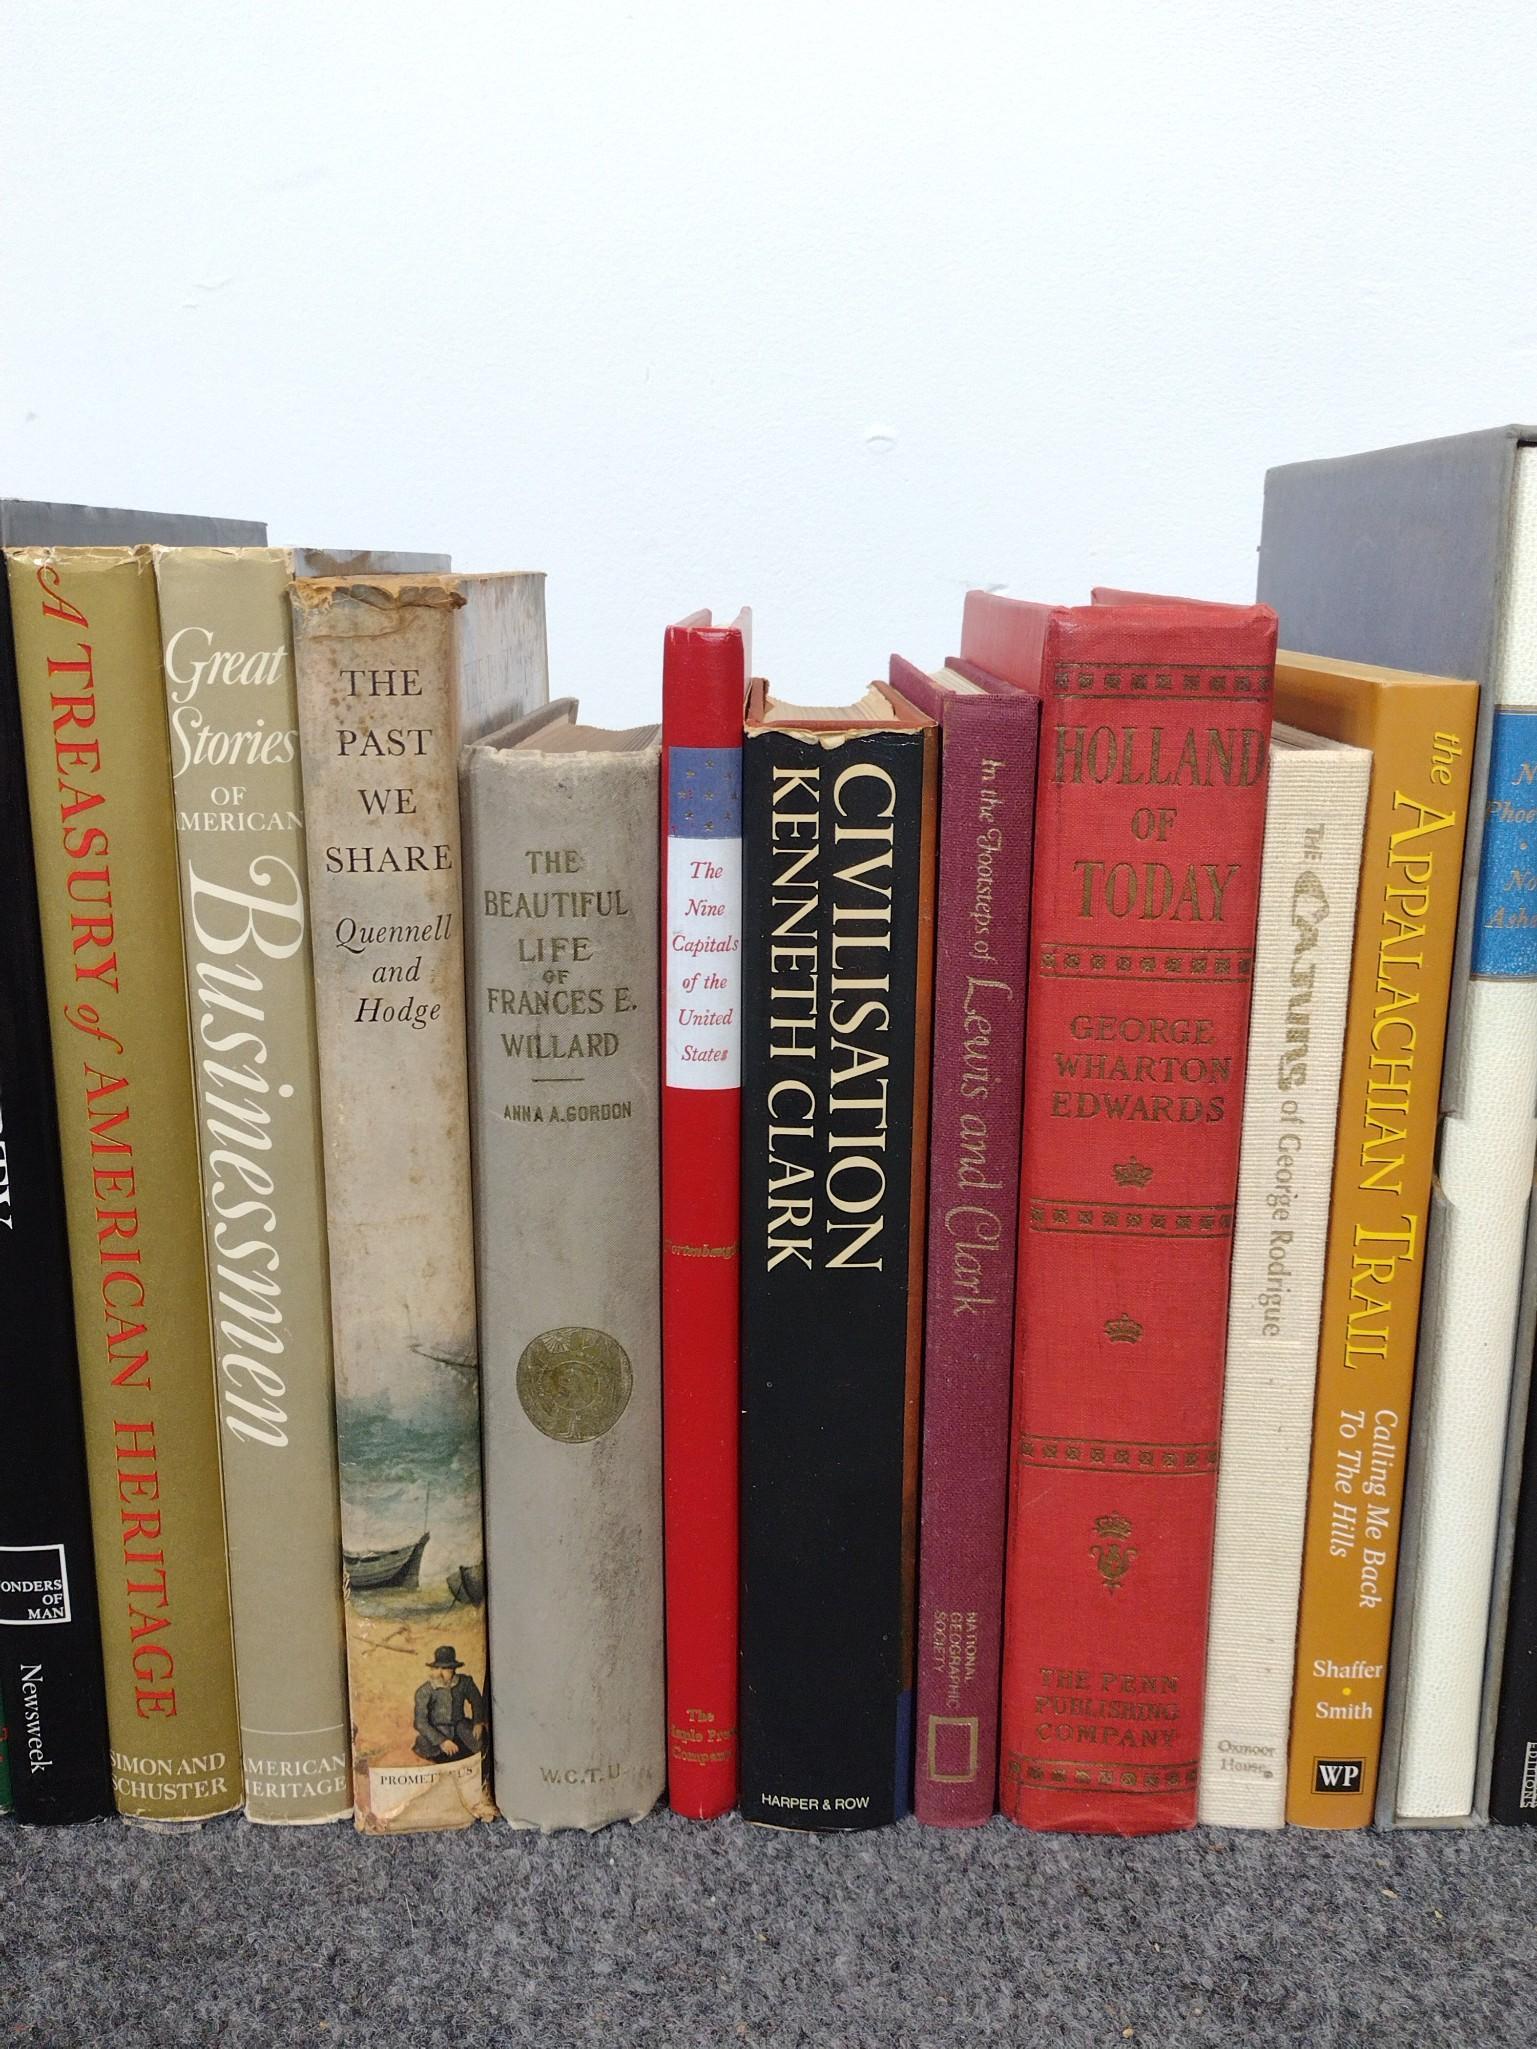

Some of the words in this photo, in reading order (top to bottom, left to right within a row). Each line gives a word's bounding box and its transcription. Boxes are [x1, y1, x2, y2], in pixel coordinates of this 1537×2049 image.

[37, 566, 89, 628] A
[165, 627, 288, 703] Great
[340, 669, 423, 697] THE
[172, 706, 298, 779] Stories
[336, 729, 433, 757] PAST
[1051, 724, 1266, 787] HOLLAND
[981, 758, 1006, 781] In
[1430, 731, 1463, 785] the
[211, 786, 247, 806] OF
[358, 788, 417, 815] WE
[978, 789, 1004, 823] the
[47, 643, 120, 994] TREASURY
[177, 811, 304, 831] MERICAN
[1131, 808, 1177, 841] OF
[1304, 823, 1325, 861] THE
[326, 844, 452, 874] SHARE
[525, 850, 582, 875] THE
[690, 861, 723, 879] The
[484, 890, 629, 919] BEAUTIFUL
[1073, 861, 1241, 921] TODAY
[684, 899, 726, 917] Nine
[770, 766, 820, 1060] KENNETH
[336, 913, 452, 954] Quennell
[672, 934, 739, 957] Capitals
[518, 937, 594, 963] LIFE
[969, 940, 998, 964] of
[372, 956, 422, 983] and
[542, 970, 571, 985] OF
[682, 972, 701, 993] of
[704, 973, 728, 990] the
[487, 988, 604, 1016] FRANCES
[615, 987, 638, 1014] E.
[1358, 789, 1456, 1194] APPALACHIAN
[354, 996, 441, 1030] Hodge
[678, 1008, 733, 1026] United
[826, 763, 896, 1272] CIVILISATION
[63, 1003, 124, 1055] of
[960, 976, 1013, 1099] Lewis
[1070, 1015, 1215, 1045] GEORGE
[501, 1033, 620, 1059] WILLARD
[681, 1045, 728, 1062] States
[1054, 1052, 1232, 1084] WHARTON
[503, 1104, 544, 1123] ANNA
[1050, 1091, 1225, 1122] EDWARDS
[1281, 1100, 1304, 1123] of
[188, 855, 305, 1447] Businessmen
[958, 1114, 1003, 1190] and
[767, 1080, 816, 1272] CLARK
[1266, 1133, 1301, 1221] George
[83, 1062, 151, 1391] AMERICAN
[944, 1205, 1001, 1316] Clark
[1258, 1230, 1295, 1337] Rodrigue
[1343, 1212, 1418, 1369] TRAIL
[1340, 1409, 1365, 1439] To
[1362, 1409, 1398, 1497] Calling
[1335, 1450, 1362, 1494] The
[1329, 1501, 1357, 1558] Hills
[1365, 1503, 1390, 1540] Me
[113, 1421, 178, 1720] HERITAGE
[1359, 1548, 1386, 1609] Back
[0, 1579, 63, 1593] ONDERS
[42, 1593, 63, 1605] OF
[28, 1606, 64, 1621] MAN
[934, 1611, 947, 1672] SOCIETY
[965, 1612, 977, 1680] NATIONAL
[946, 1612, 962, 1708] GEOGRAPHIC
[1313, 1659, 1384, 1678] Shaffer
[1040, 1668, 1089, 1689] THE
[1102, 1672, 1179, 1694] PENN
[20, 1663, 53, 1775] Newsweek
[1035, 1696, 1180, 1721] PUBLISHING
[1315, 1701, 1372, 1719] Smith
[1036, 1723, 1177, 1747] COMPANY
[1218, 1740, 1276, 1757] Oxmoor
[177, 1752, 226, 1775] AND
[1319, 1765, 1359, 1787] WP
[761, 1793, 819, 1810] HARPER
[822, 1799, 831, 1811] &
[835, 1796, 870, 1810] ROW
